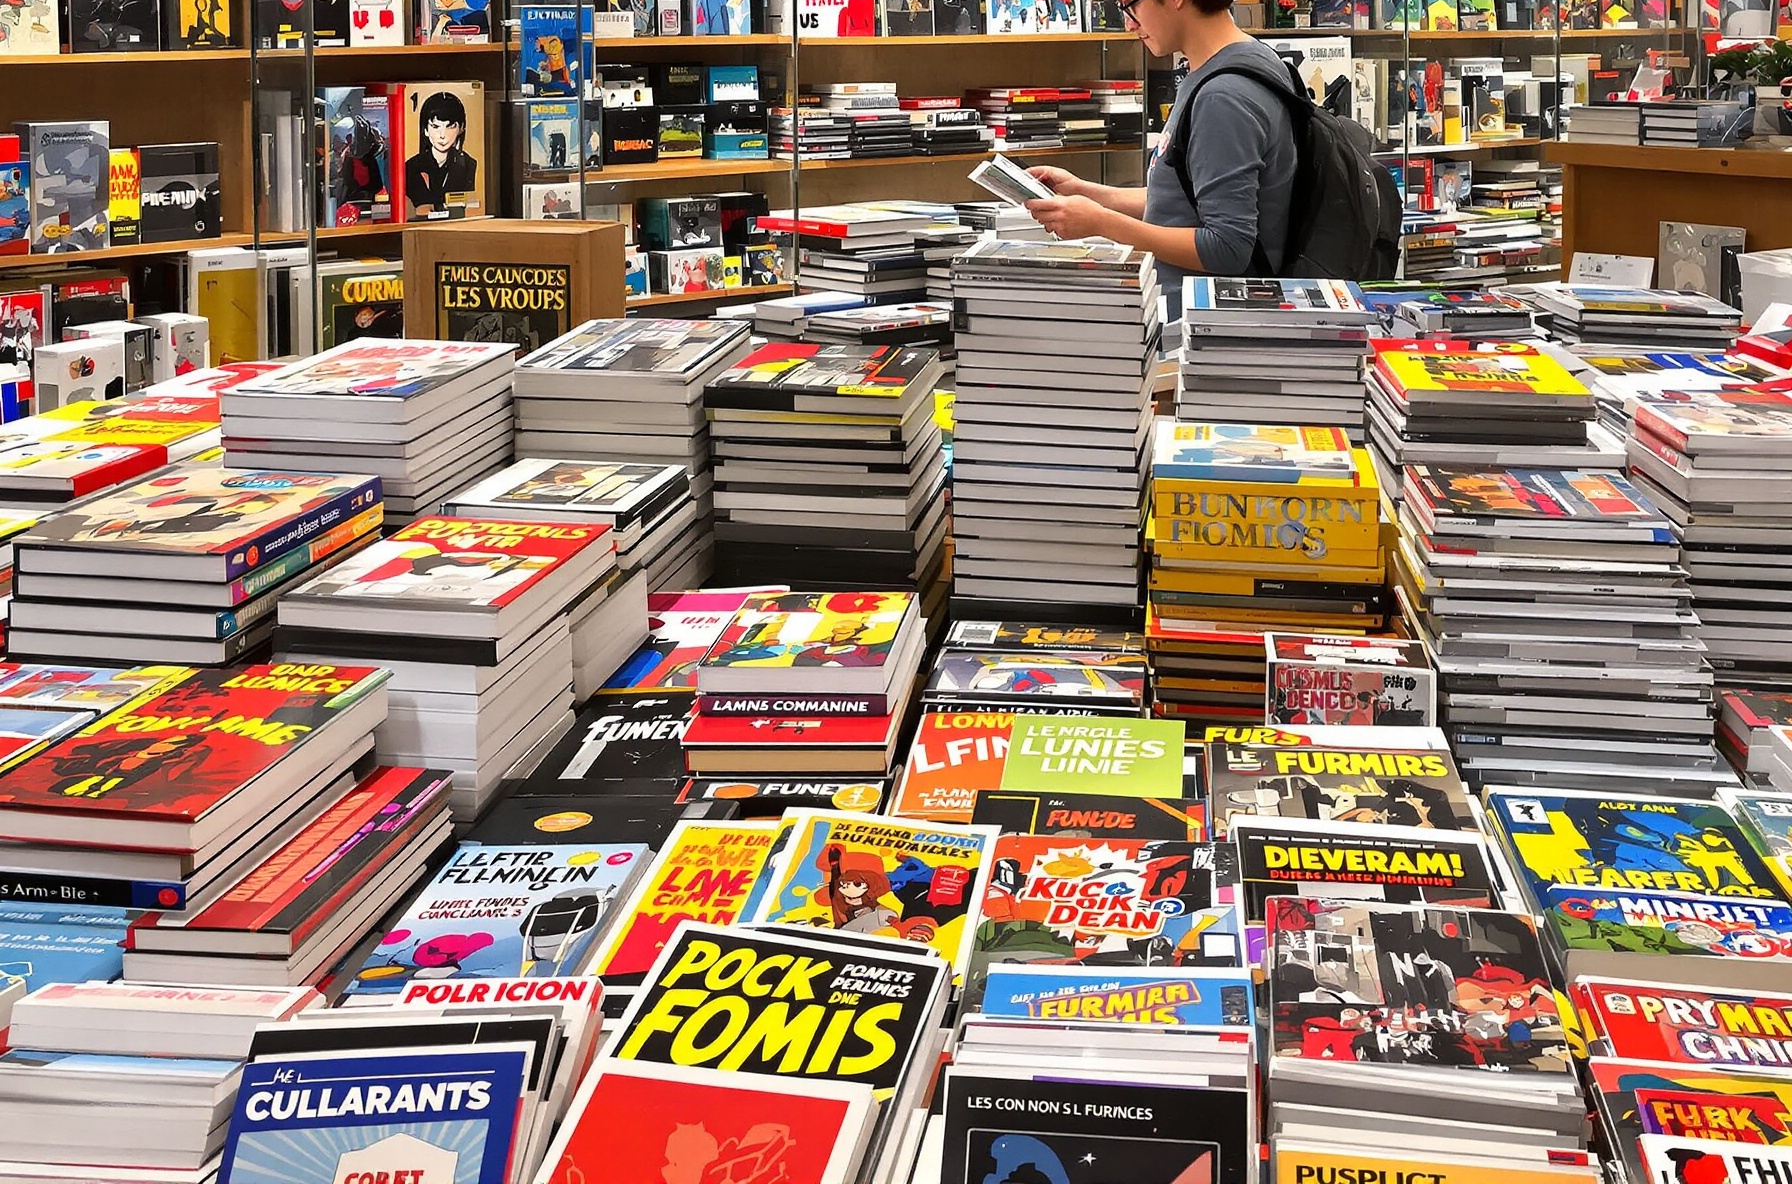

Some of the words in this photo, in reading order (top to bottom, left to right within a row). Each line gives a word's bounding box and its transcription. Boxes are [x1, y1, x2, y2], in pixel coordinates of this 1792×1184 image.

[442, 285, 481, 308] LES
[485, 287, 565, 310] VROUPS
[1026, 725, 1055, 737] LE
[1204, 727, 1302, 747] FURS
[1020, 737, 1166, 759] LUNIES
[1226, 750, 1257, 763] LE
[1274, 752, 1449, 778] FURMIRS
[1263, 844, 1465, 878] DIEVERAM!
[1048, 905, 1160, 929] DEAN
[659, 939, 834, 1002] POCK
[617, 987, 904, 1076] FOMIS
[245, 1081, 492, 1121] CULLARANTS
[966, 1096, 991, 1110] LES
[995, 1098, 1026, 1112] CON
[1028, 1100, 1061, 1114] NON
[1063, 1102, 1071, 1115] S
[1073, 1104, 1082, 1116] L
[1084, 1104, 1154, 1121] FURINCES
[1651, 1101, 1762, 1131] FURK
